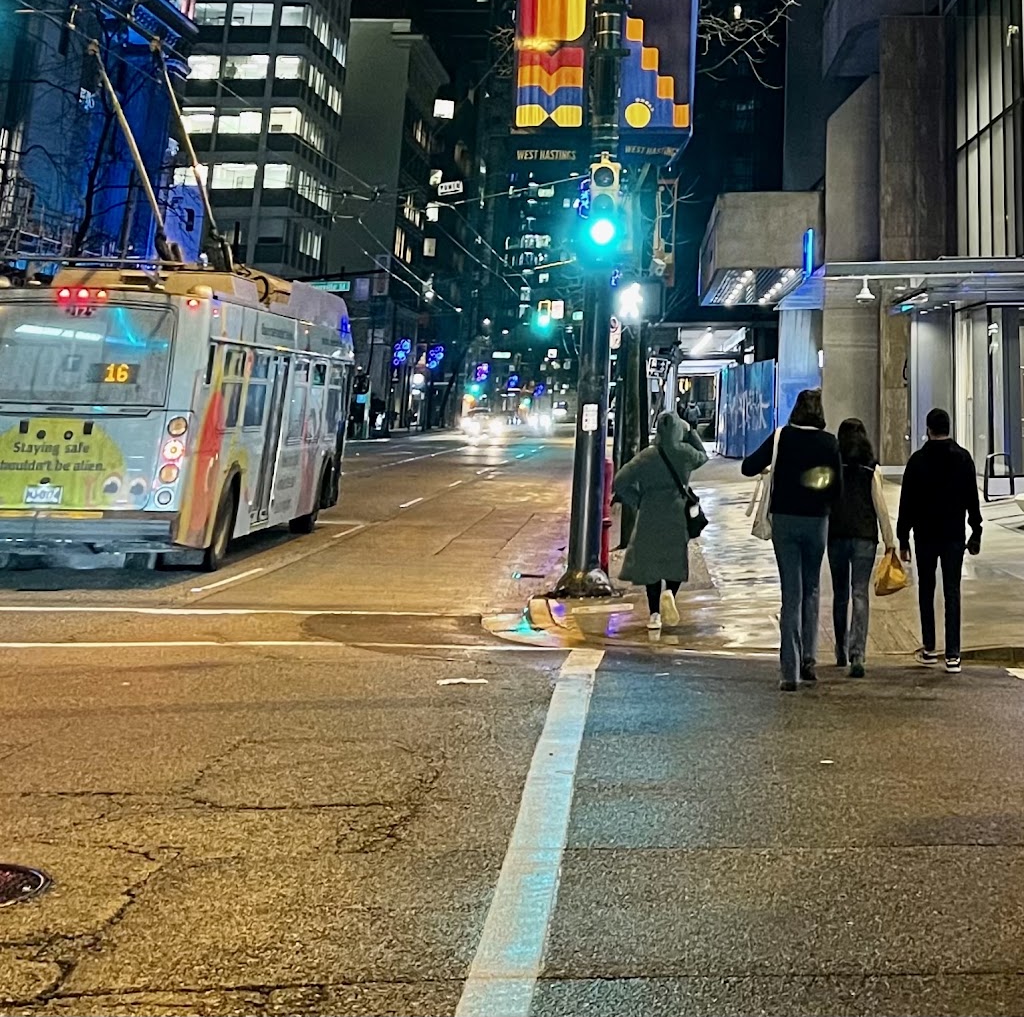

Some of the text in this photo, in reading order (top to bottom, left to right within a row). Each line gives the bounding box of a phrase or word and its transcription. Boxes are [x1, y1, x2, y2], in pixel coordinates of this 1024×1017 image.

[517, 149, 577, 160] WEST HASTINGS
[625, 145, 645, 154] WEST
[104, 363, 129, 382] 16
[13, 441, 90, 456] Staying safe
[54, 459, 71, 472] be
[73, 459, 106, 472] alien.
